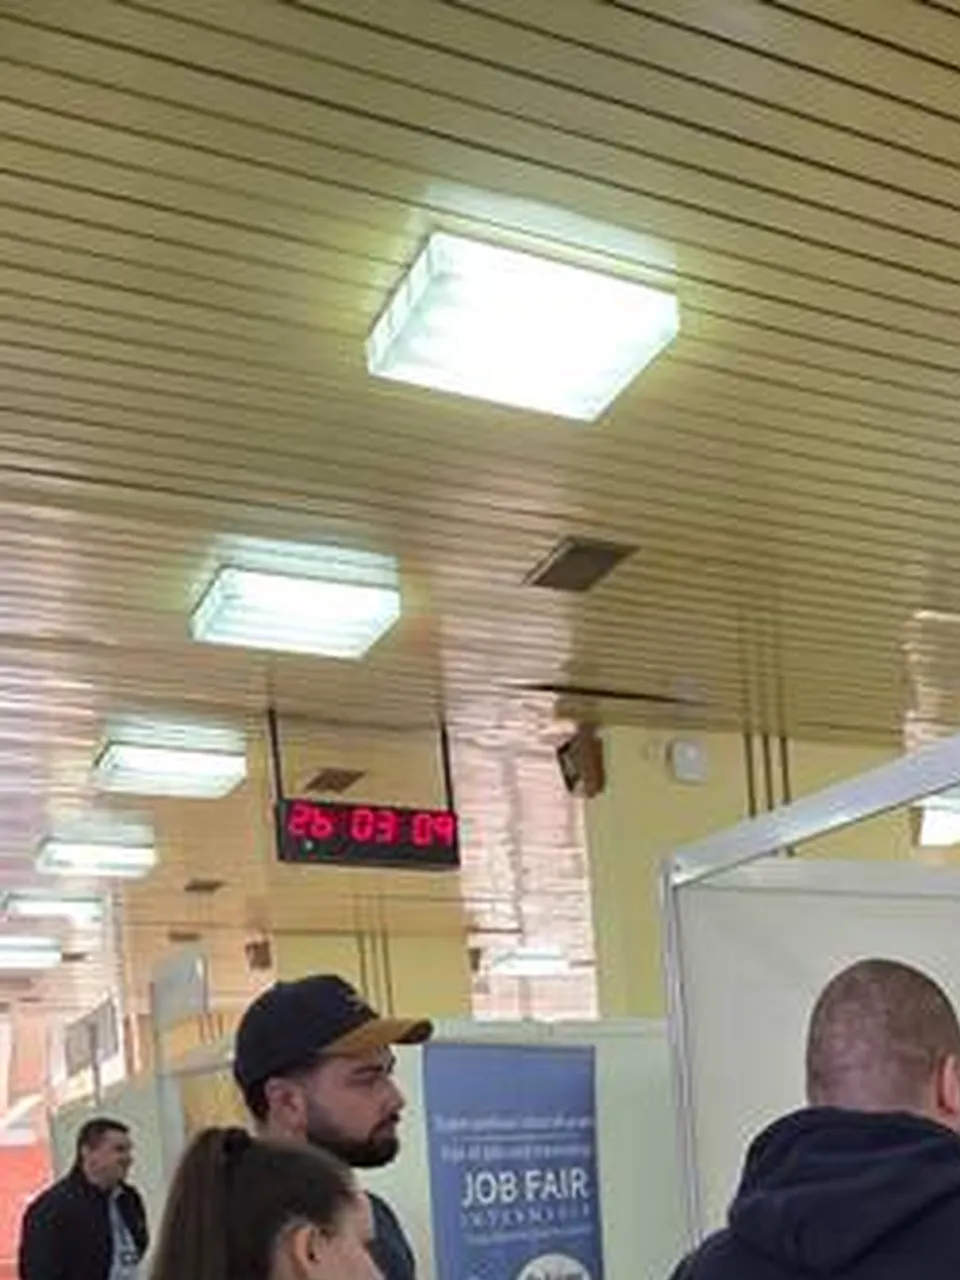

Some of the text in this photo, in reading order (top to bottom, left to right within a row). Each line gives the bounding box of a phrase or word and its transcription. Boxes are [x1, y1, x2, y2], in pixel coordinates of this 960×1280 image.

[350, 807, 397, 844] 03
[461, 1167, 590, 1208] JOB FAIR
